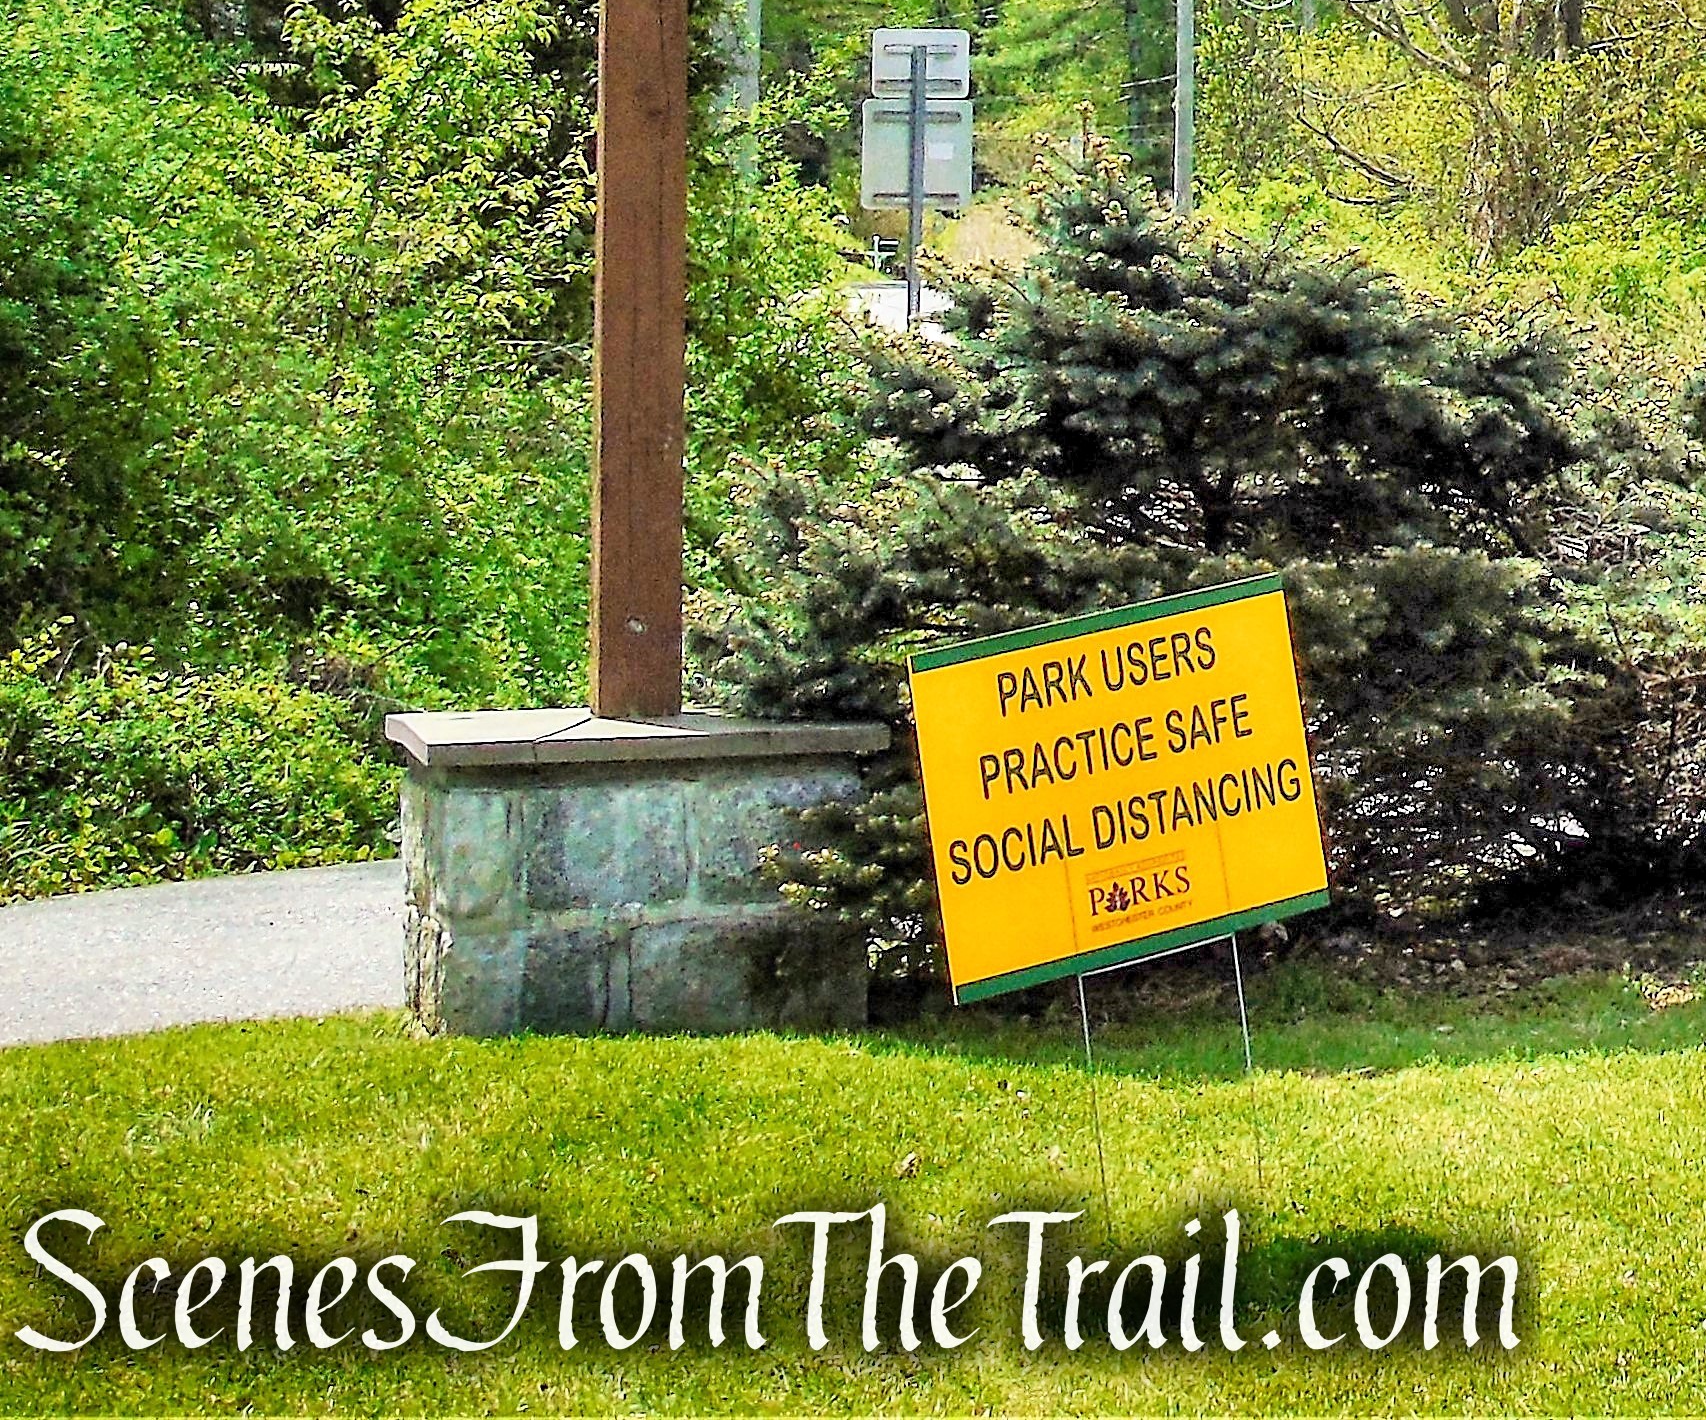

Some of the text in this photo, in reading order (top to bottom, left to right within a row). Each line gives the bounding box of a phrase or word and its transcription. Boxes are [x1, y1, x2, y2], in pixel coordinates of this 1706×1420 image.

[996, 626, 1217, 718] PARK USERS
[979, 693, 1254, 801] PRACTICE SAFE
[948, 814, 1085, 886] SOCIAL
[1091, 758, 1302, 851] DISTANCING
